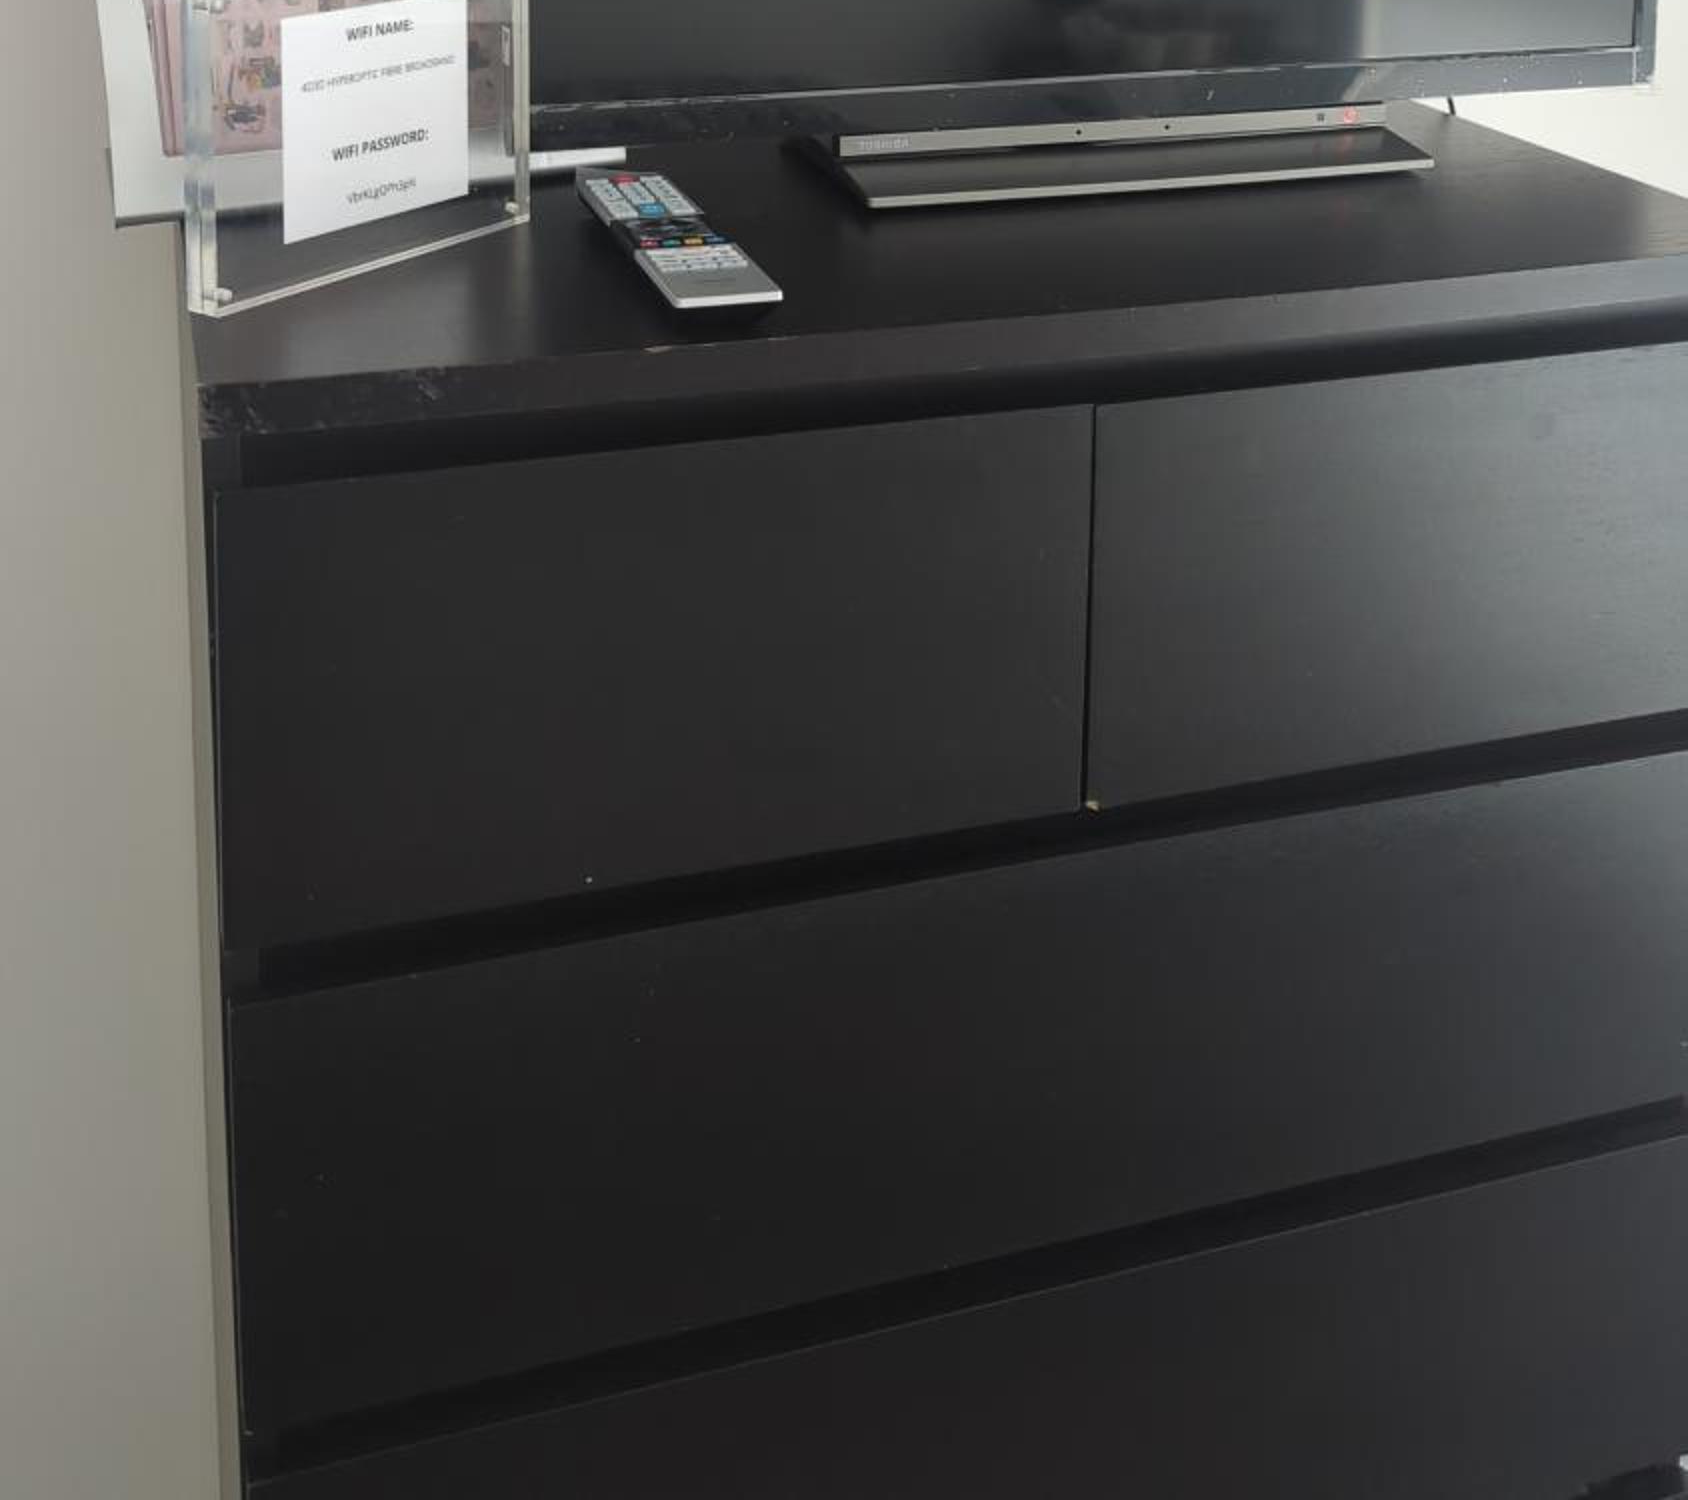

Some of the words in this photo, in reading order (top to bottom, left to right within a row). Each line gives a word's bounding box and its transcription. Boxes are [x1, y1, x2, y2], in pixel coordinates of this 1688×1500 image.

[346, 23, 372, 41] WIFI
[375, 18, 414, 37] NAME:
[332, 143, 359, 161] WIFI
[361, 128, 429, 154] PASSWORD:
